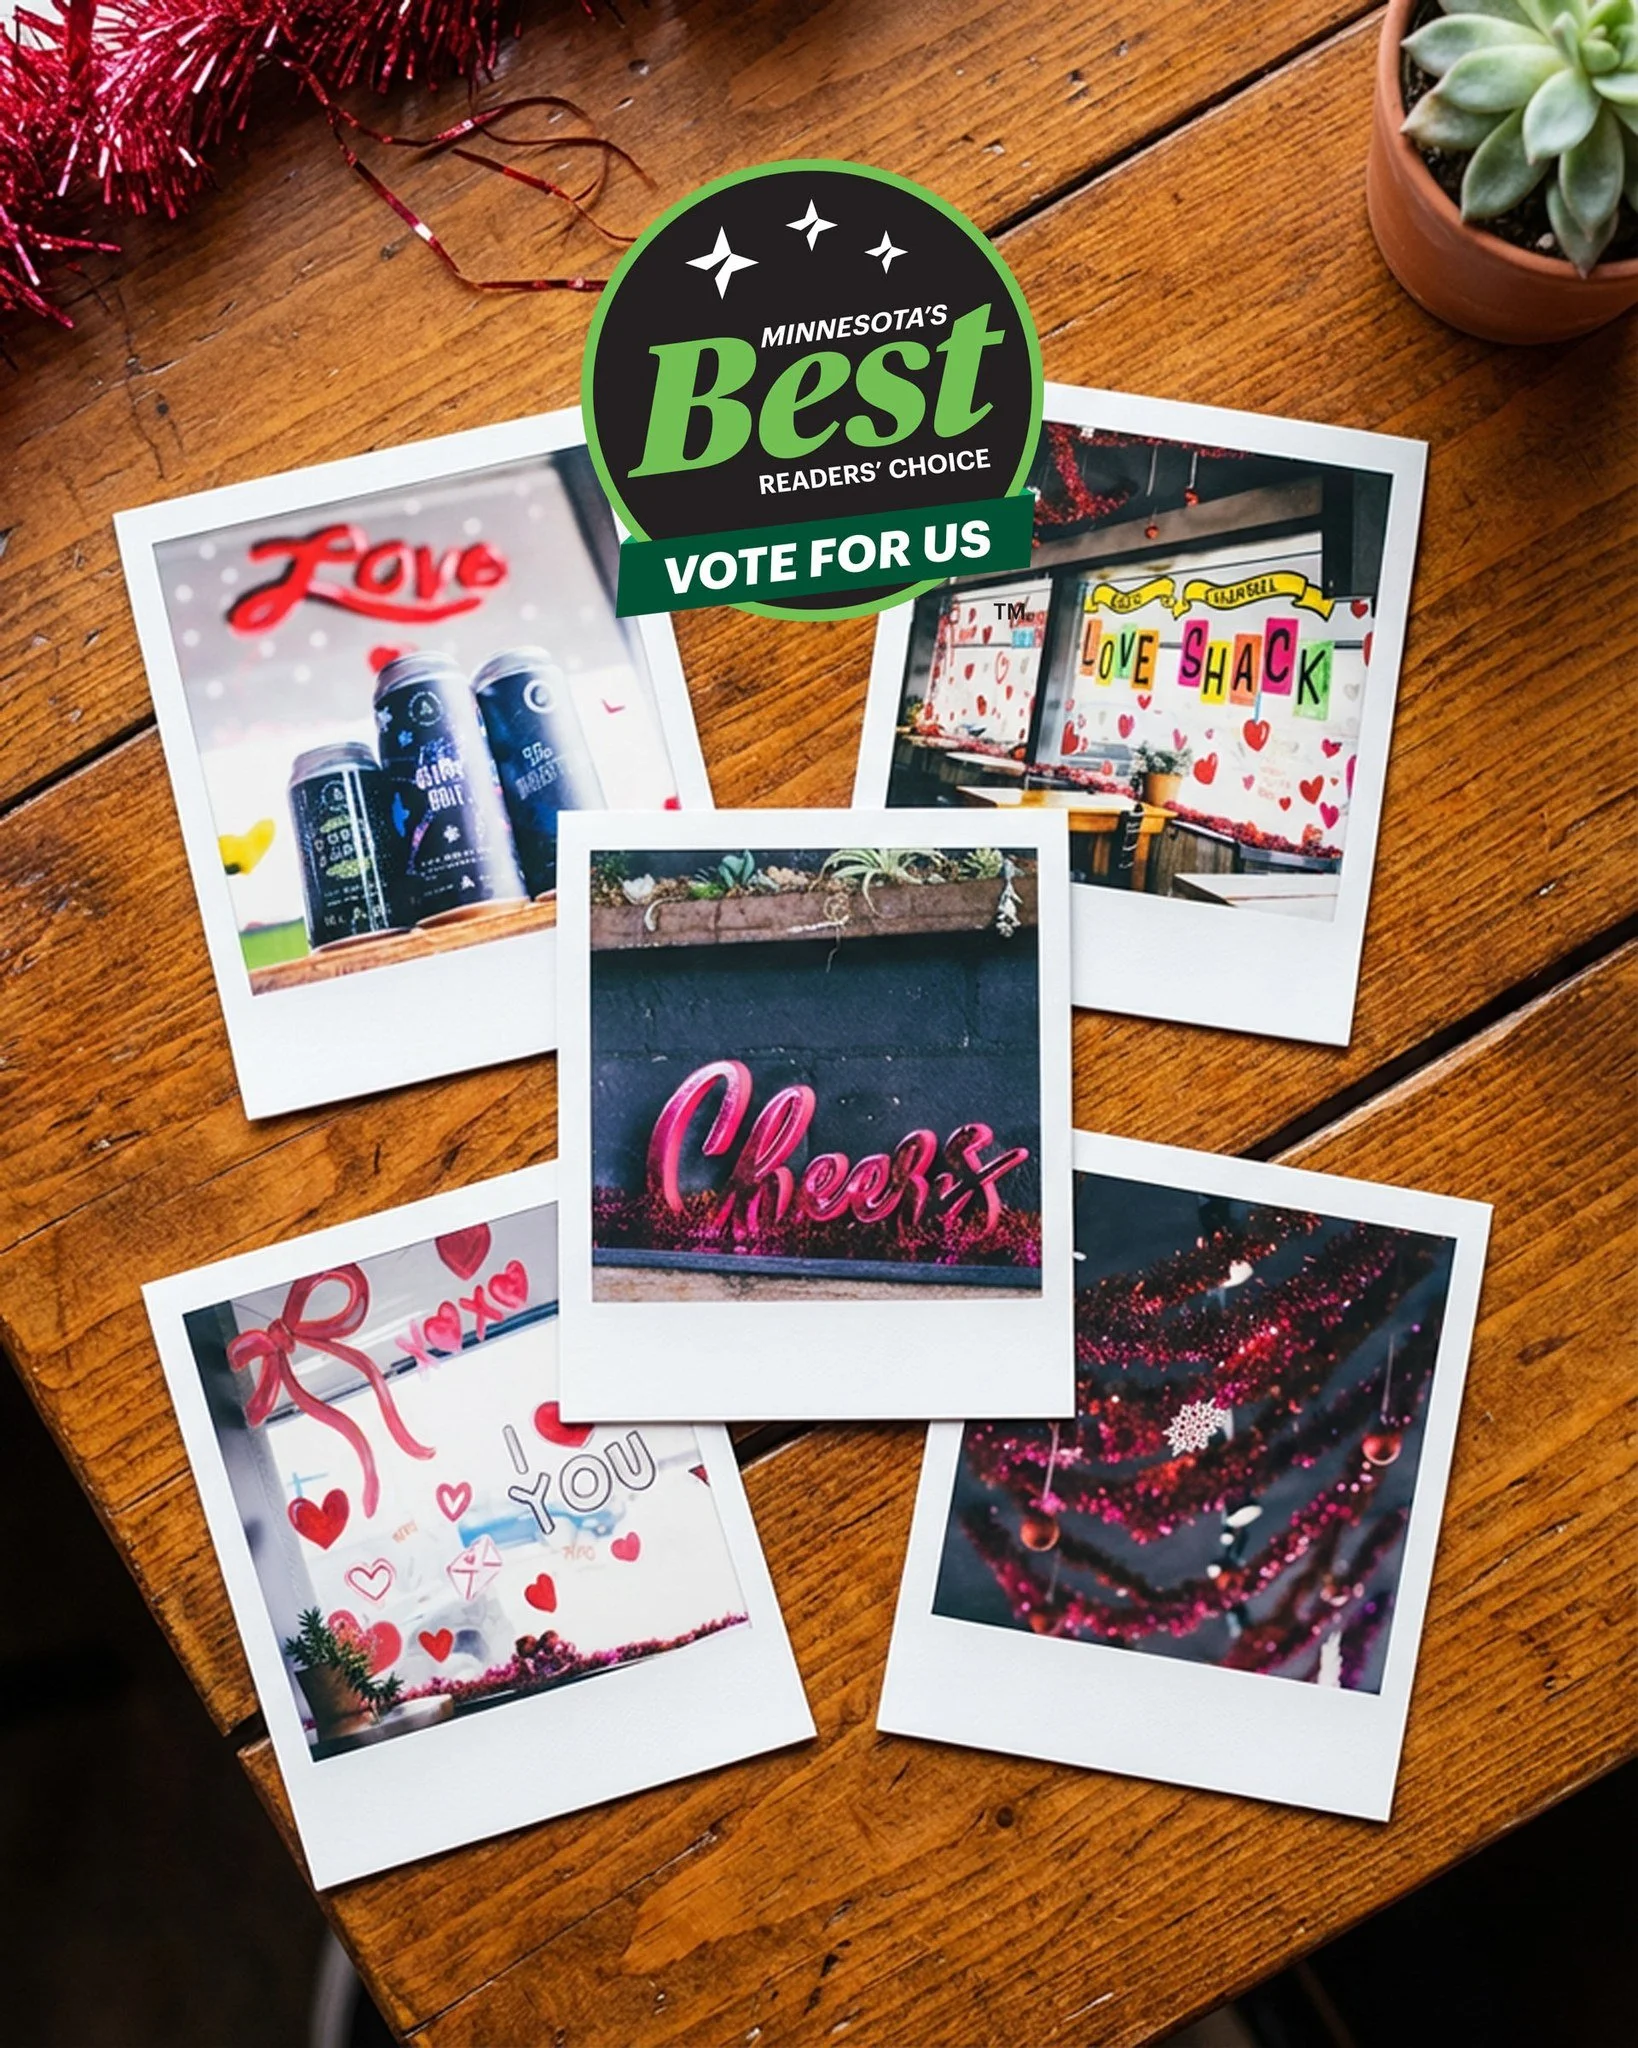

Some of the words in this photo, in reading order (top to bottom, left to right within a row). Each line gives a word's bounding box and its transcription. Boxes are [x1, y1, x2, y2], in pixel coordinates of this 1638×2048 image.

[1081, 619, 1155, 686] LOVE
[1180, 626, 1327, 706] SHACK
[502, 1424, 529, 1476] I
[508, 1430, 657, 1535] YOU
